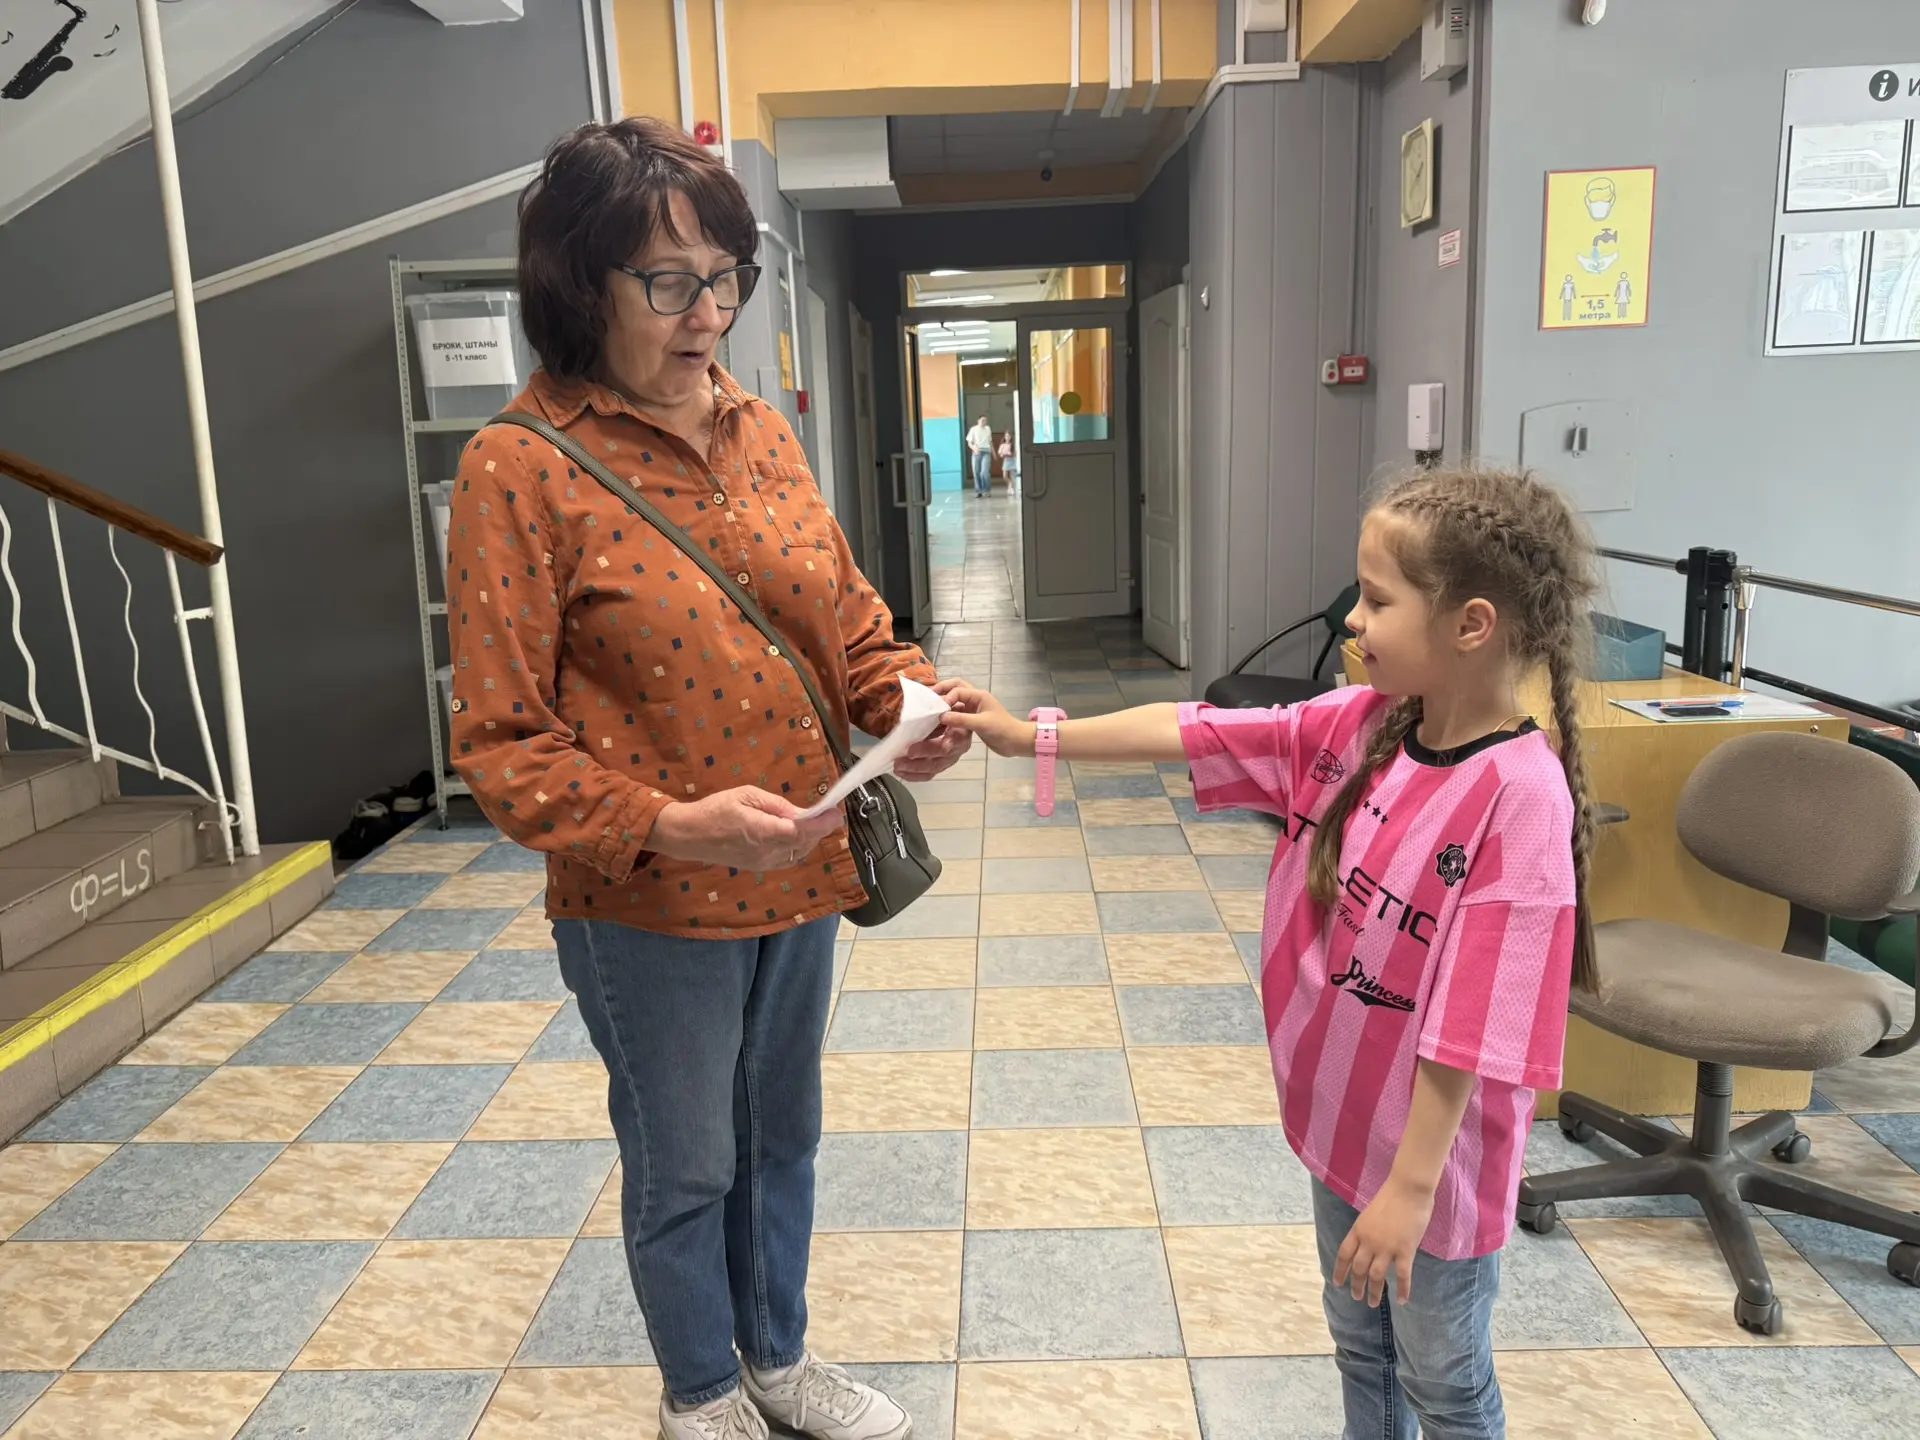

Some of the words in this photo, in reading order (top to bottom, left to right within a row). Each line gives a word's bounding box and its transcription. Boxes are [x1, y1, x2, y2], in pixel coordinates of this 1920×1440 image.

[1587, 299, 1605, 311] 1,5
[1579, 312, 1611, 320] метра
[1335, 902, 1366, 937] Fast
